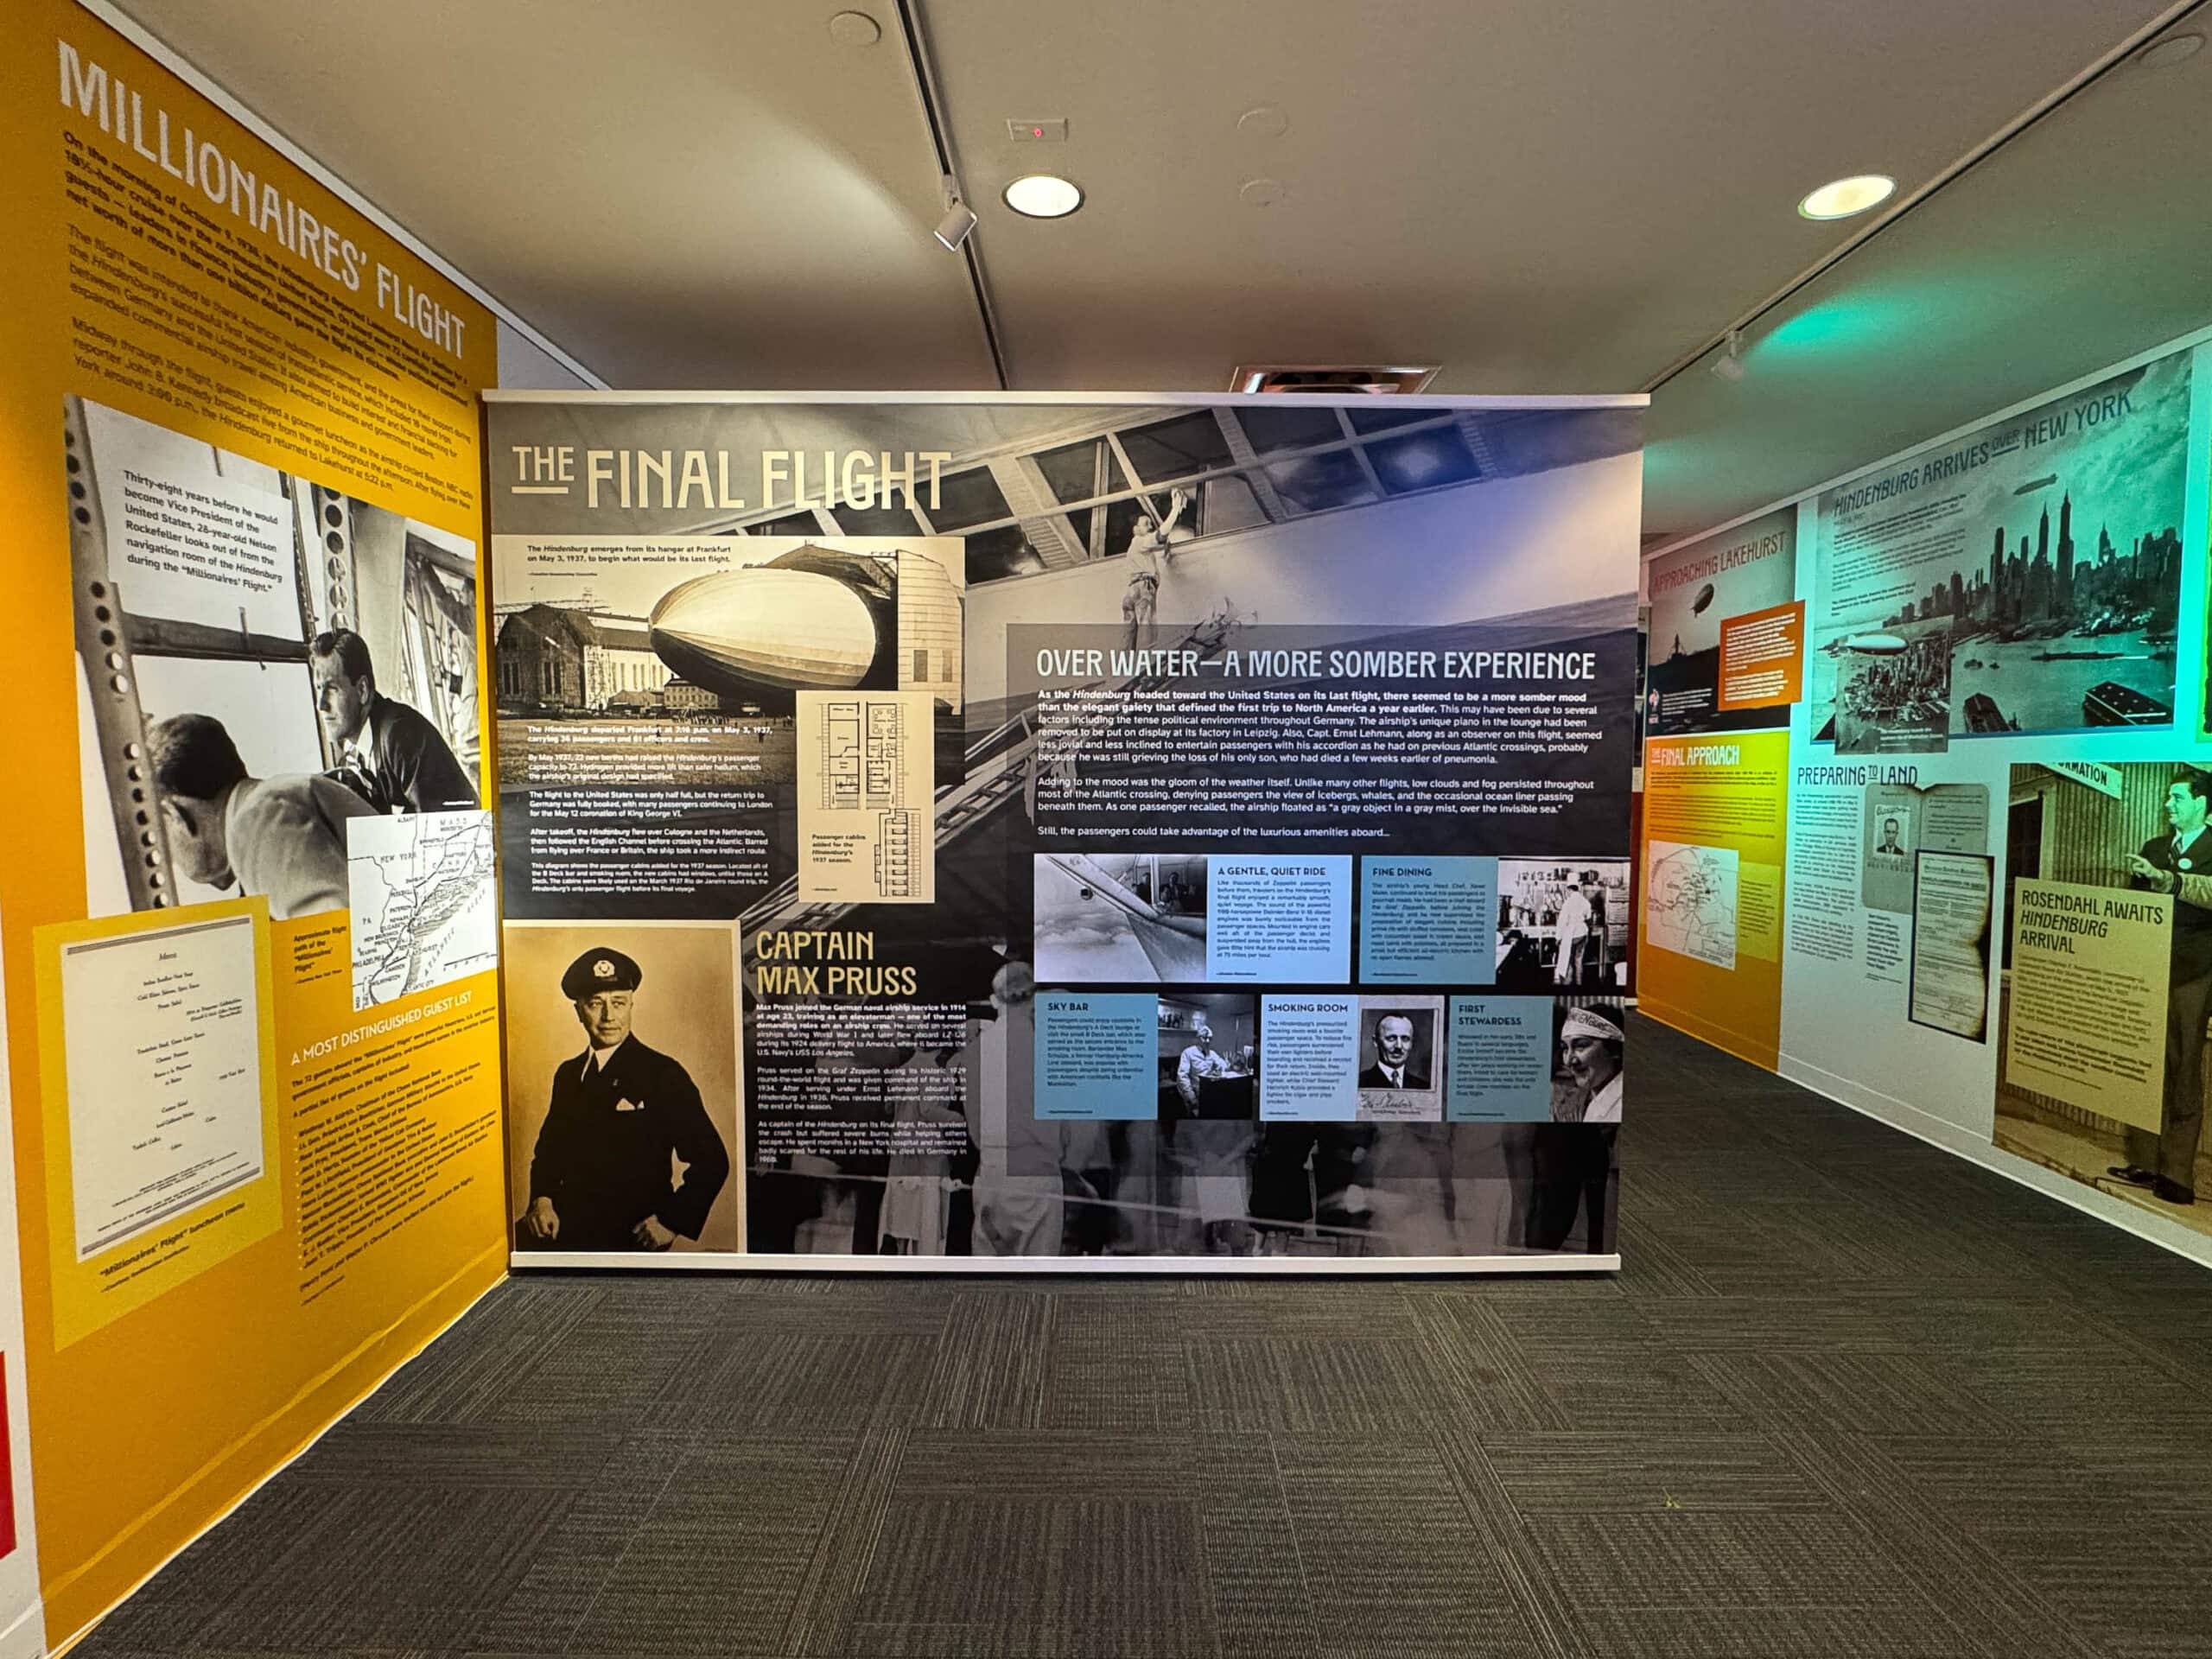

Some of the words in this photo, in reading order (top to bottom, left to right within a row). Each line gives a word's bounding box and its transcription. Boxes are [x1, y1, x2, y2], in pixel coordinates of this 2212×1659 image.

[59, 38, 367, 292] MILLIONAIRES'
[377, 263, 465, 359] FLIGHT
[1834, 467, 1920, 517] HINDENBURG
[1922, 442, 1990, 486] ARRIVES
[1993, 429, 2020, 451] OVER
[2024, 412, 2069, 449] NEW
[2074, 390, 2133, 431] YORK
[512, 446, 575, 482] THE
[588, 450, 745, 509] FINAL
[762, 450, 952, 510] FLIGHT
[124, 469, 183, 496] Thirty-eight
[185, 490, 211, 505] years
[212, 497, 240, 513] before
[242, 506, 252, 518] he
[254, 512, 278, 525] would
[124, 486, 164, 506] become
[167, 499, 188, 513] Vice
[190, 505, 233, 526] President
[235, 519, 244, 529] of
[245, 523, 259, 534] the
[124, 503, 159, 521] United
[161, 513, 195, 532] States,
[197, 523, 247, 544] 28-year-old
[248, 537, 277, 553] Nelson
[125, 519, 182, 543] Rockefeller
[184, 535, 210, 550] looks
[212, 543, 226, 554] out
[228, 547, 238, 556] of
[239, 549, 259, 562] from
[261, 556, 275, 566] the
[543, 545, 588, 554] Hindenburg
[658, 545, 685, 554] hangar
[126, 538, 180, 557] navigation
[181, 551, 207, 563] room
[207, 556, 218, 566] of
[219, 559, 234, 570] the
[235, 563, 283, 583] Hindenburg
[127, 553, 161, 571] during
[162, 562, 179, 573] the
[538, 555, 555, 563] May
[708, 555, 730, 564] flight.
[1653, 557, 1718, 594] APPROACHING
[1719, 531, 1786, 571] LAKEHURST
[1037, 649, 1103, 677] OVER
[1249, 650, 1322, 677] MORE
[1329, 650, 1437, 678] SOMBER
[1444, 651, 1596, 680] EXPERIENCE
[1038, 690, 1052, 699] As
[1054, 690, 1071, 699] the
[1072, 689, 1131, 702] Hindenburg
[1134, 690, 1170, 699] headed
[1172, 690, 1206, 700] toward
[1209, 690, 1225, 700] the
[1228, 690, 1261, 700] United
[1263, 690, 1296, 700] States
[1313, 690, 1327, 700] its
[1329, 690, 1349, 700] last
[1351, 690, 1381, 702] flight,
[1382, 691, 1409, 701] there
[1412, 691, 1451, 701] seemed
[1453, 692, 1465, 701] to
[1466, 692, 1479, 702] be
[1519, 692, 1557, 702] somber
[1558, 693, 1587, 702] mood
[1662, 747, 1685, 766] FINAL
[1687, 745, 1740, 766] APPROACH
[1798, 767, 1866, 785] PREPARING
[1868, 765, 1878, 778] TO
[1880, 766, 1917, 785] LAND
[530, 809, 540, 817] for
[554, 809, 569, 818] May
[579, 809, 618, 817] coronation
[626, 810, 644, 819] King
[645, 809, 671, 819] George
[1037, 826, 1058, 836] Still,
[1060, 826, 1076, 836] the
[1077, 828, 1130, 837] passengers
[1132, 826, 1158, 836] could
[1160, 827, 1180, 836] take
[1181, 827, 1230, 838] advantage
[1230, 826, 1241, 836] of
[1243, 827, 1258, 836] the
[1260, 827, 1301, 836] luxurious
[1303, 827, 1349, 837] amenities
[1217, 867, 1225, 875] A
[1227, 867, 1269, 876] GENTLE,
[1270, 867, 1301, 876] QUIET
[1303, 867, 1326, 876] RIDE
[1372, 868, 1395, 876] FINE
[1397, 868, 1433, 877] DINING
[2022, 890, 2100, 916] ROSENDAHL
[2104, 900, 2164, 925] AWAITS
[2020, 911, 2108, 938] HINDENBURG
[756, 930, 874, 960] CAPTAIN
[2020, 930, 2075, 954] ARRIVAL
[758, 966, 820, 995] MAX
[828, 966, 917, 995] PRUSS
[794, 1003, 818, 1013] joined
[885, 1003, 911, 1013] airship
[1047, 1002, 1067, 1011] SKY
[1069, 1002, 1089, 1012] BAR
[1268, 1003, 1315, 1013] SMOKING
[1316, 1003, 1349, 1013] ROOM
[1459, 1004, 1485, 1014] FIRST
[291, 1052, 301, 1065] A
[303, 1038, 340, 1060] MOST
[340, 1008, 422, 1047] DISTINGUISHED
[423, 999, 453, 1017] GUEST
[454, 990, 473, 1007] LIST
[1458, 1016, 1522, 1026] STEWARDESS
